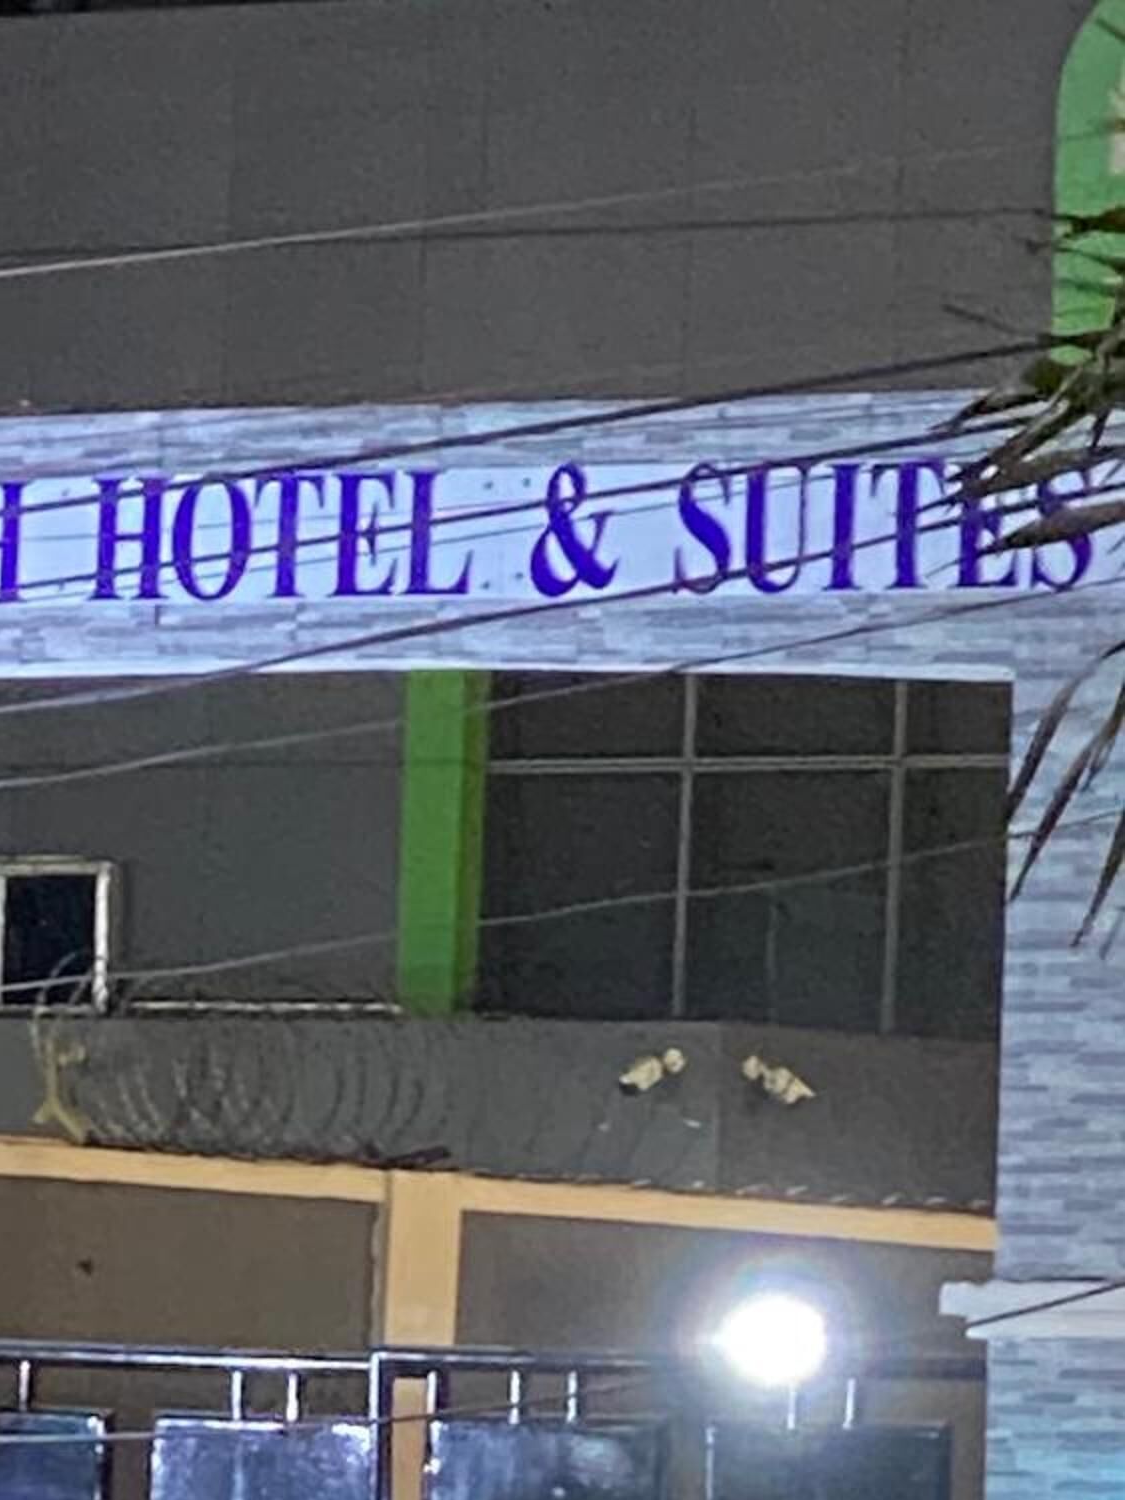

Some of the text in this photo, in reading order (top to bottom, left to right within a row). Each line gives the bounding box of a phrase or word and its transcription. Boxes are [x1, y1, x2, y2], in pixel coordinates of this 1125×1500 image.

[92, 466, 472, 601] HOTEL
[529, 461, 619, 598] &
[672, 456, 1094, 594] SUITES
